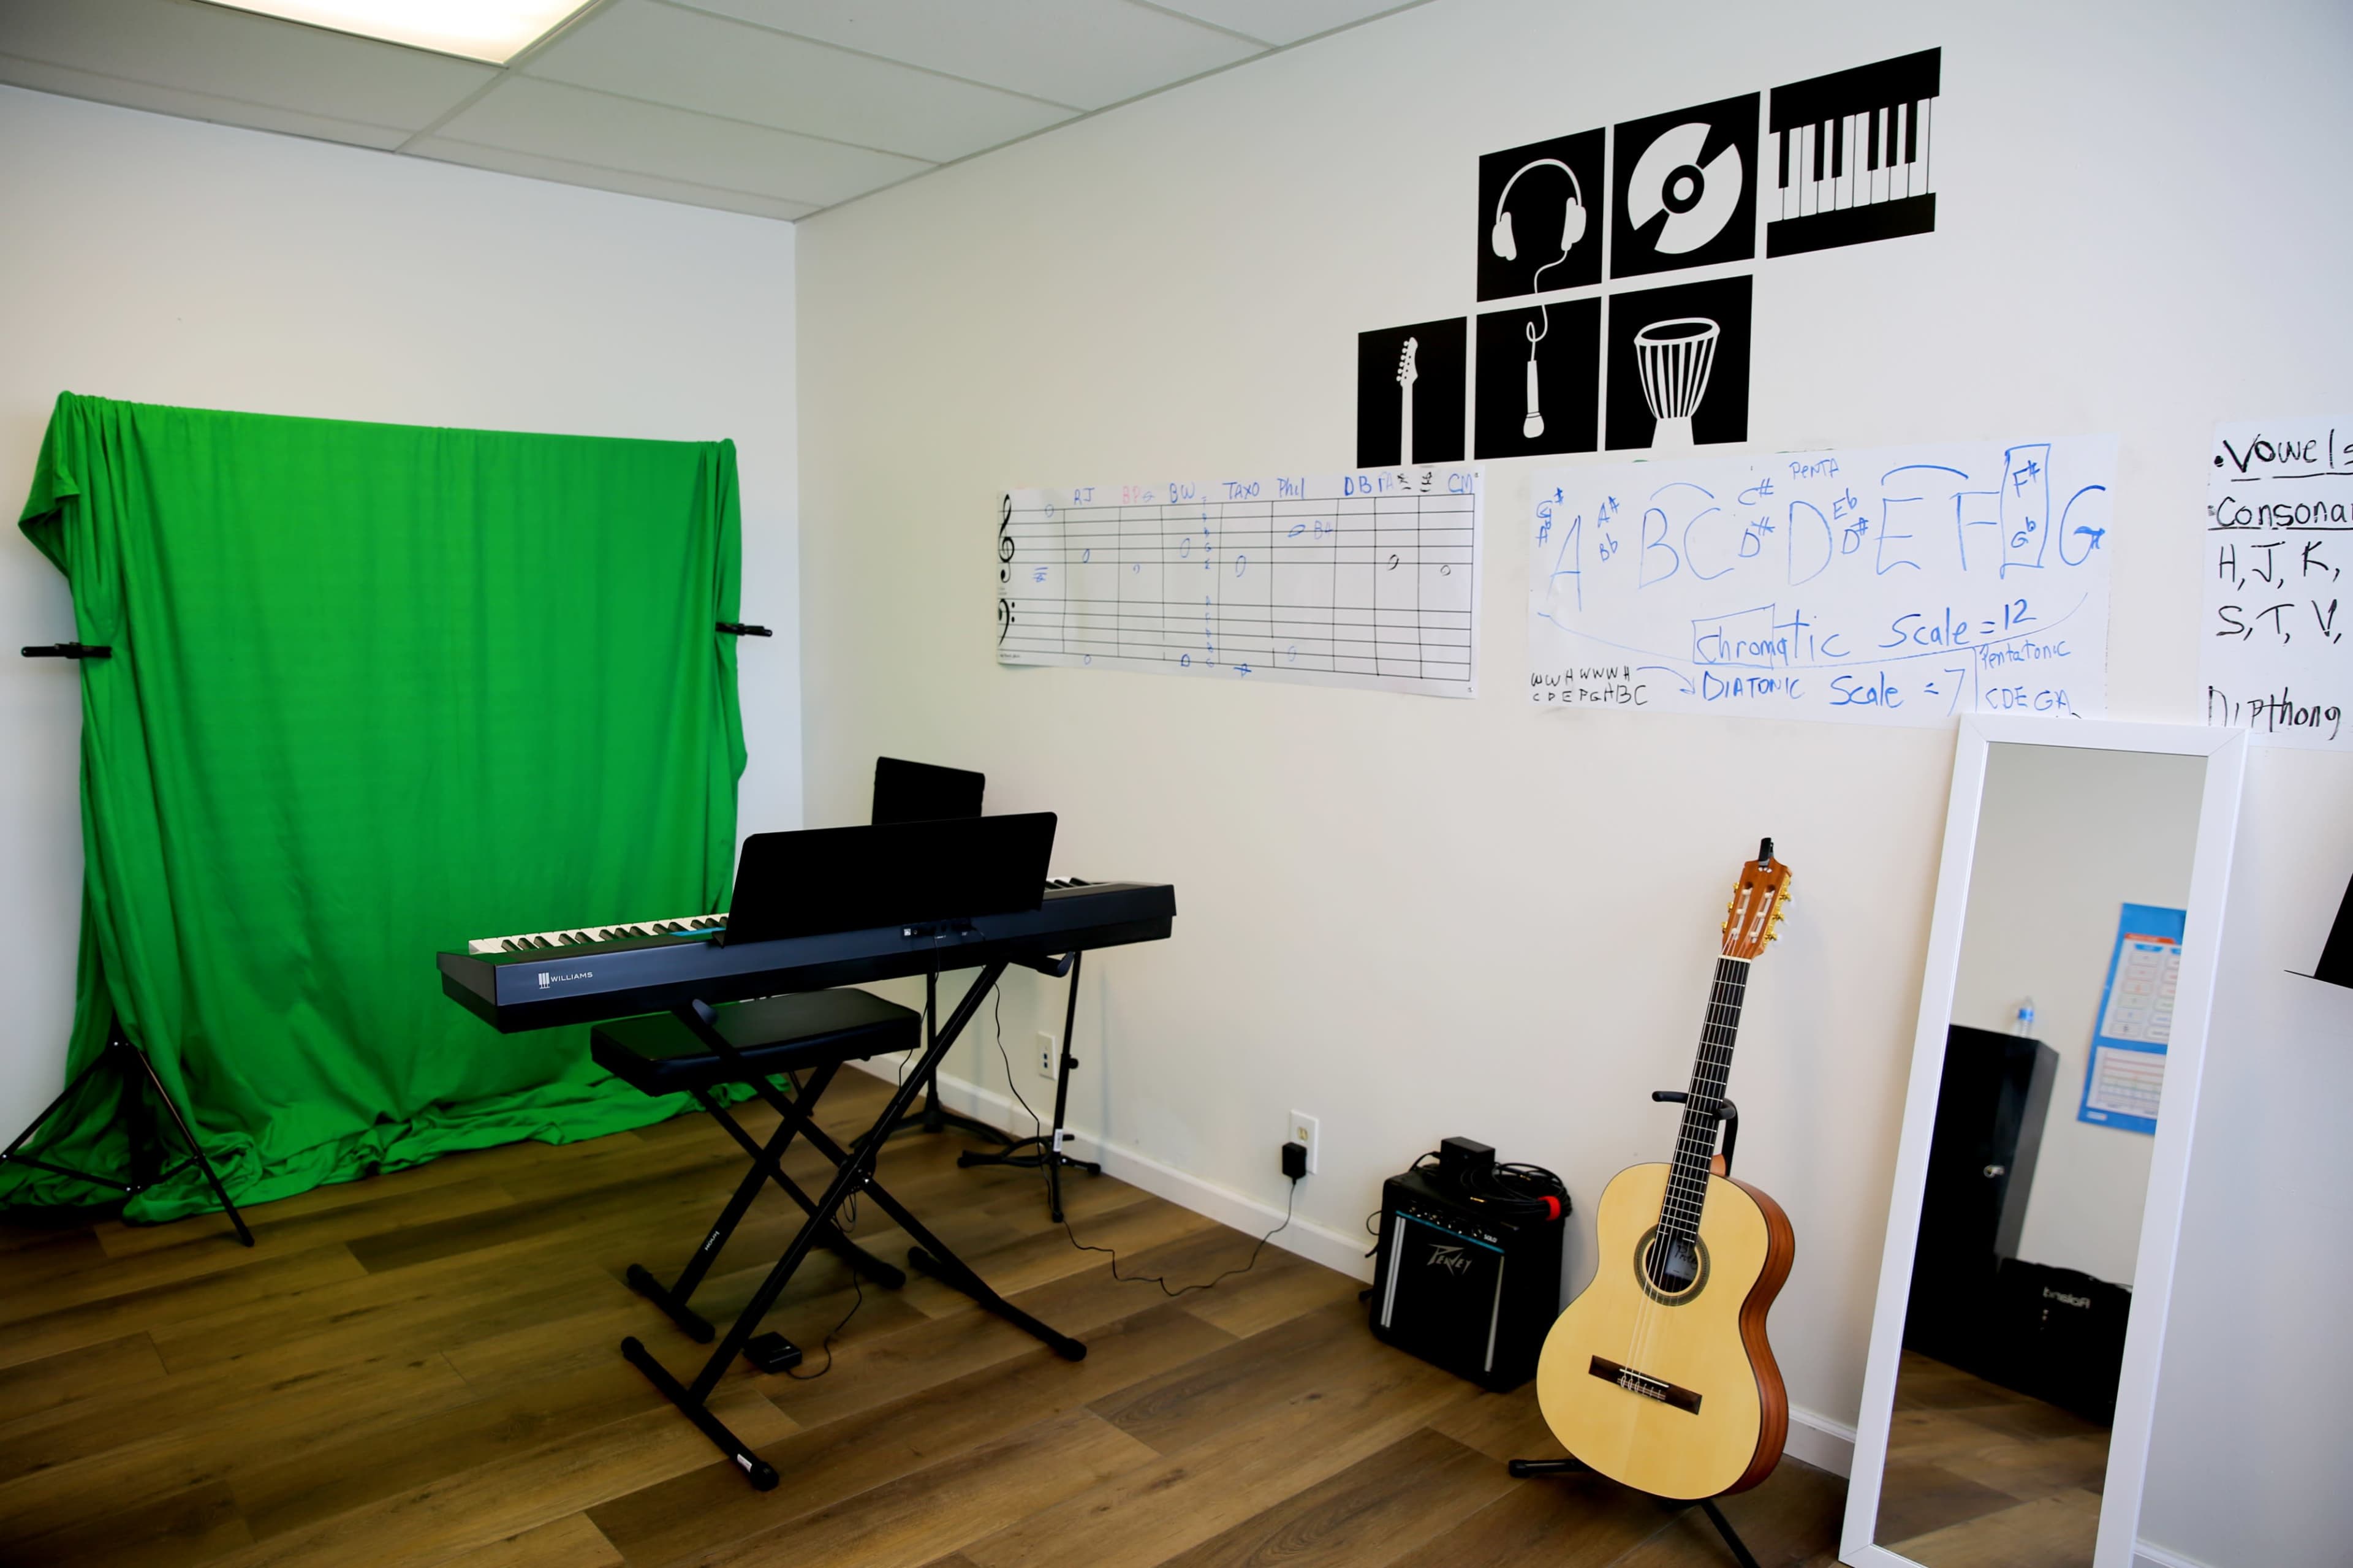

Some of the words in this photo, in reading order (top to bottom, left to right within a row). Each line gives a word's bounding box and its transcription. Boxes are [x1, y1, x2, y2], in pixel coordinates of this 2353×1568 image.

[1879, 607, 1970, 648] Scale
[1829, 671, 1904, 708] Scale
[550, 972, 593, 982] WILLIAMS
